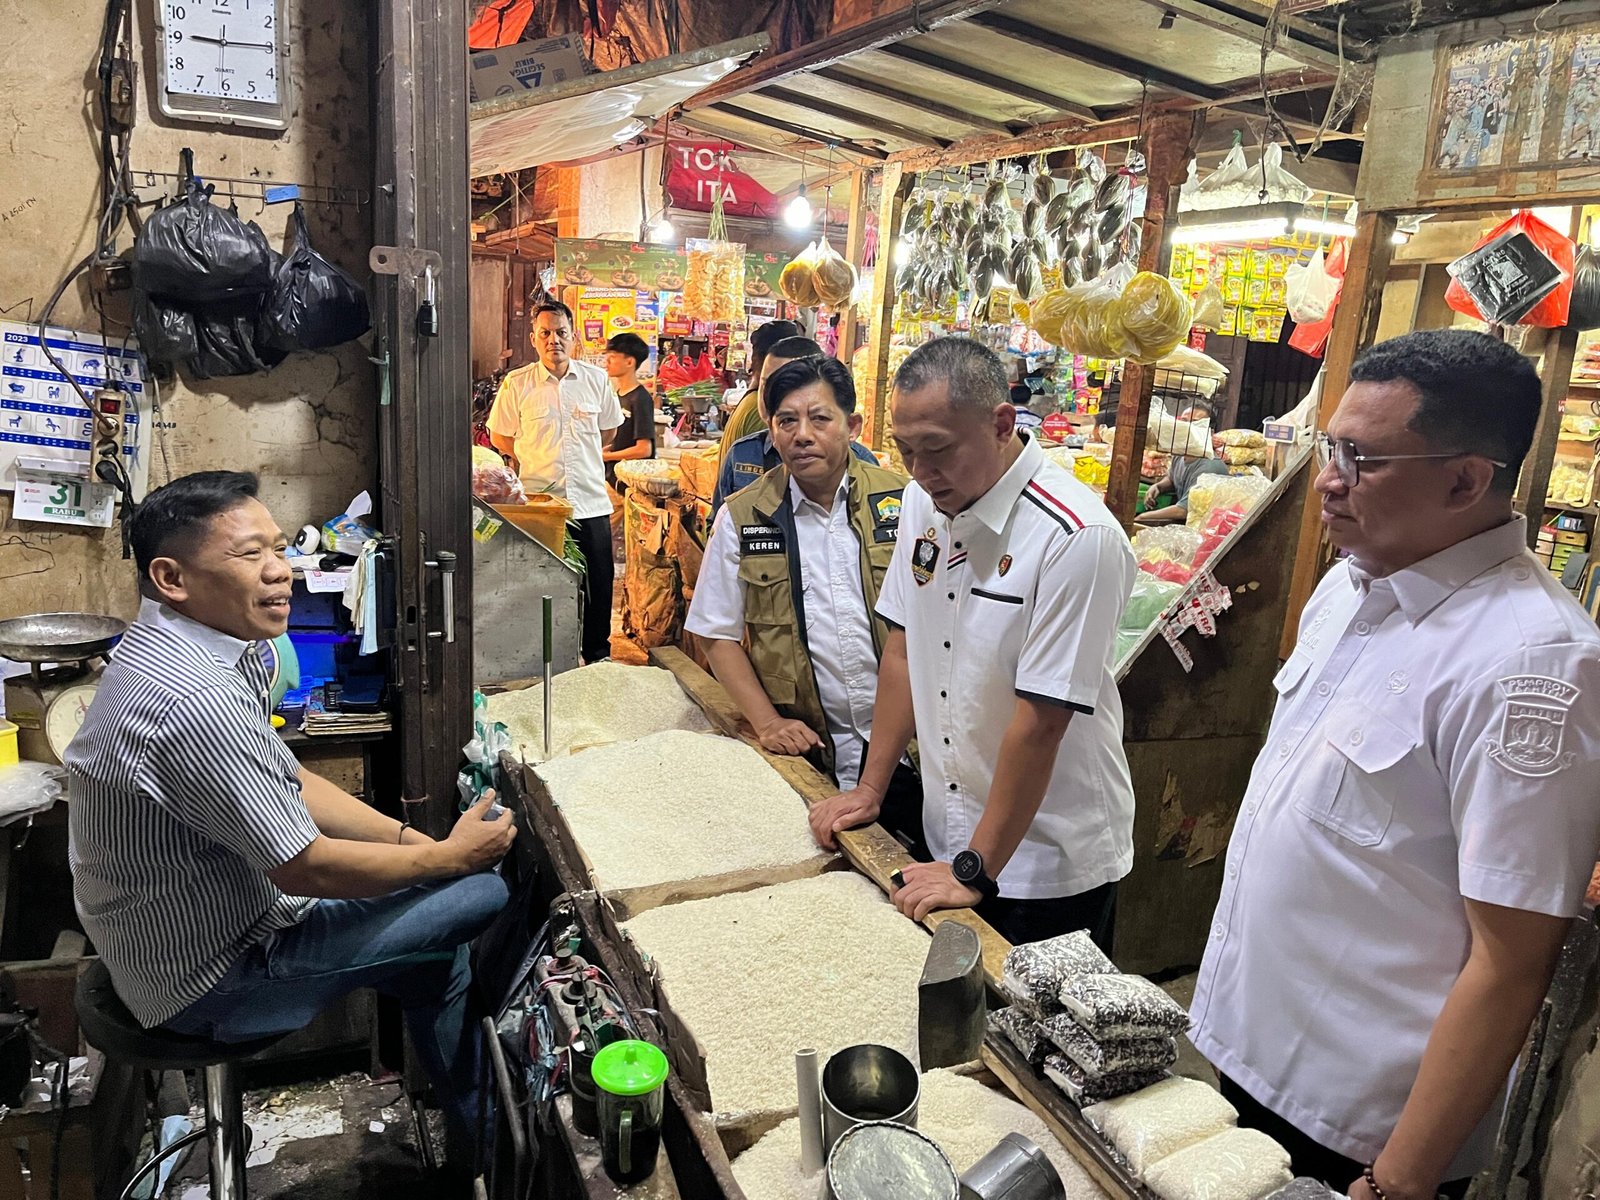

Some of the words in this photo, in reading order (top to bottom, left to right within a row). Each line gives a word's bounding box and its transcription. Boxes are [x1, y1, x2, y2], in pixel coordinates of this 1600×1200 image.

[172, 5, 186, 20] 10
[264, 15, 273, 29] 2
[173, 30, 183, 44] 9
[264, 41, 274, 55] 3
[175, 56, 185, 70] 8
[515, 57, 535, 67] BIRU
[214, 67, 235, 75] QUARTZ
[265, 67, 275, 80] 4
[509, 62, 546, 77] SEGITIGA
[196, 74, 205, 88] 7
[221, 78, 231, 92] 6
[246, 80, 256, 94] 5
[697, 180, 738, 205] ITA
[6, 334, 29, 343] 2023
[49, 481, 82, 507] 31
[51, 507, 77, 516] RABU
[749, 542, 780, 551] KEREN
[1511, 705, 1562, 719] BANTEN
